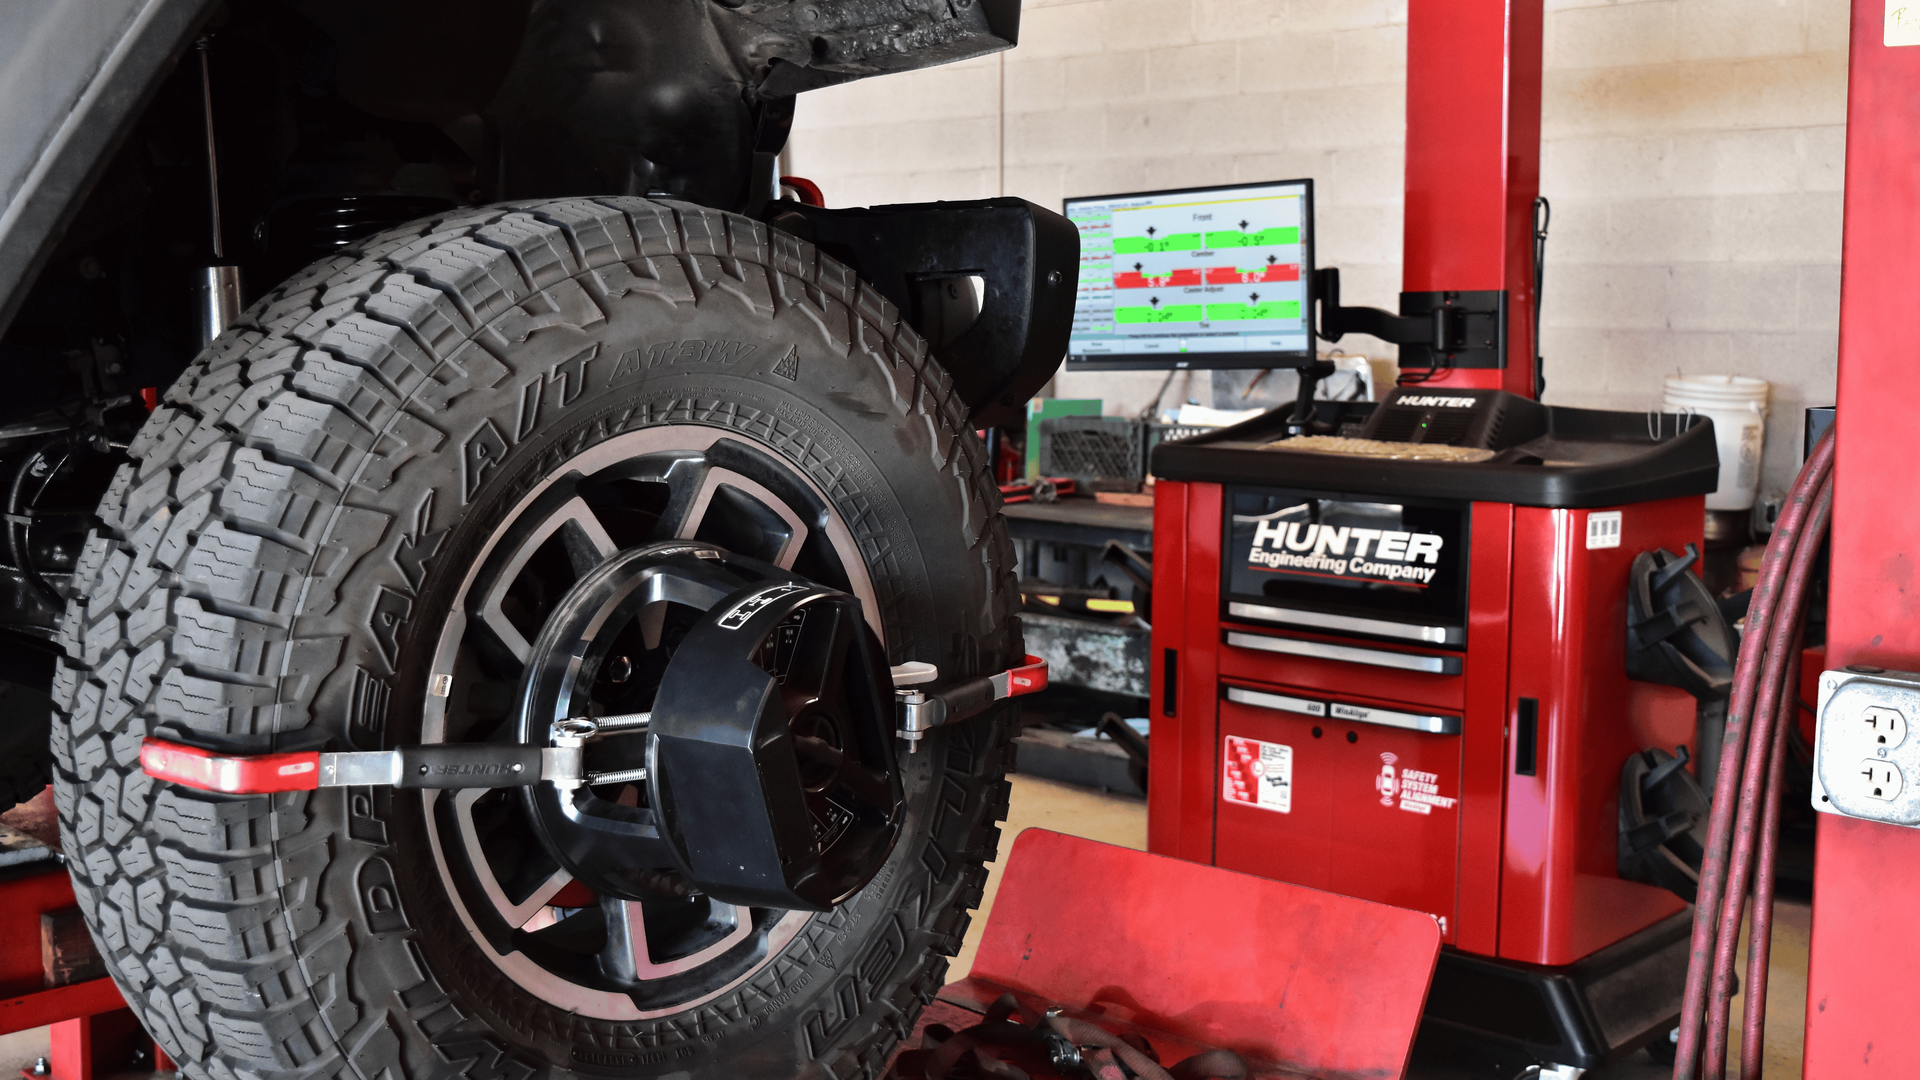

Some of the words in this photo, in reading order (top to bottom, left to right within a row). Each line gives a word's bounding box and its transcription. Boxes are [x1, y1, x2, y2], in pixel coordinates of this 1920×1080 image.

[1193, 212, 1212, 222] Front
[1191, 249, 1215, 258] Camber
[1396, 395, 1476, 408] HUNTER
[460, 341, 600, 505] A/T
[1252, 520, 1443, 564] HUNTER
[1248, 547, 1347, 575] Engineering
[1349, 556, 1436, 584] Company
[1401, 768, 1438, 784] SAFETY
[1401, 778, 1439, 795] SYSTEM
[1399, 789, 1457, 809] ALIGNMENT
[789, 971, 814, 996] LOAD
